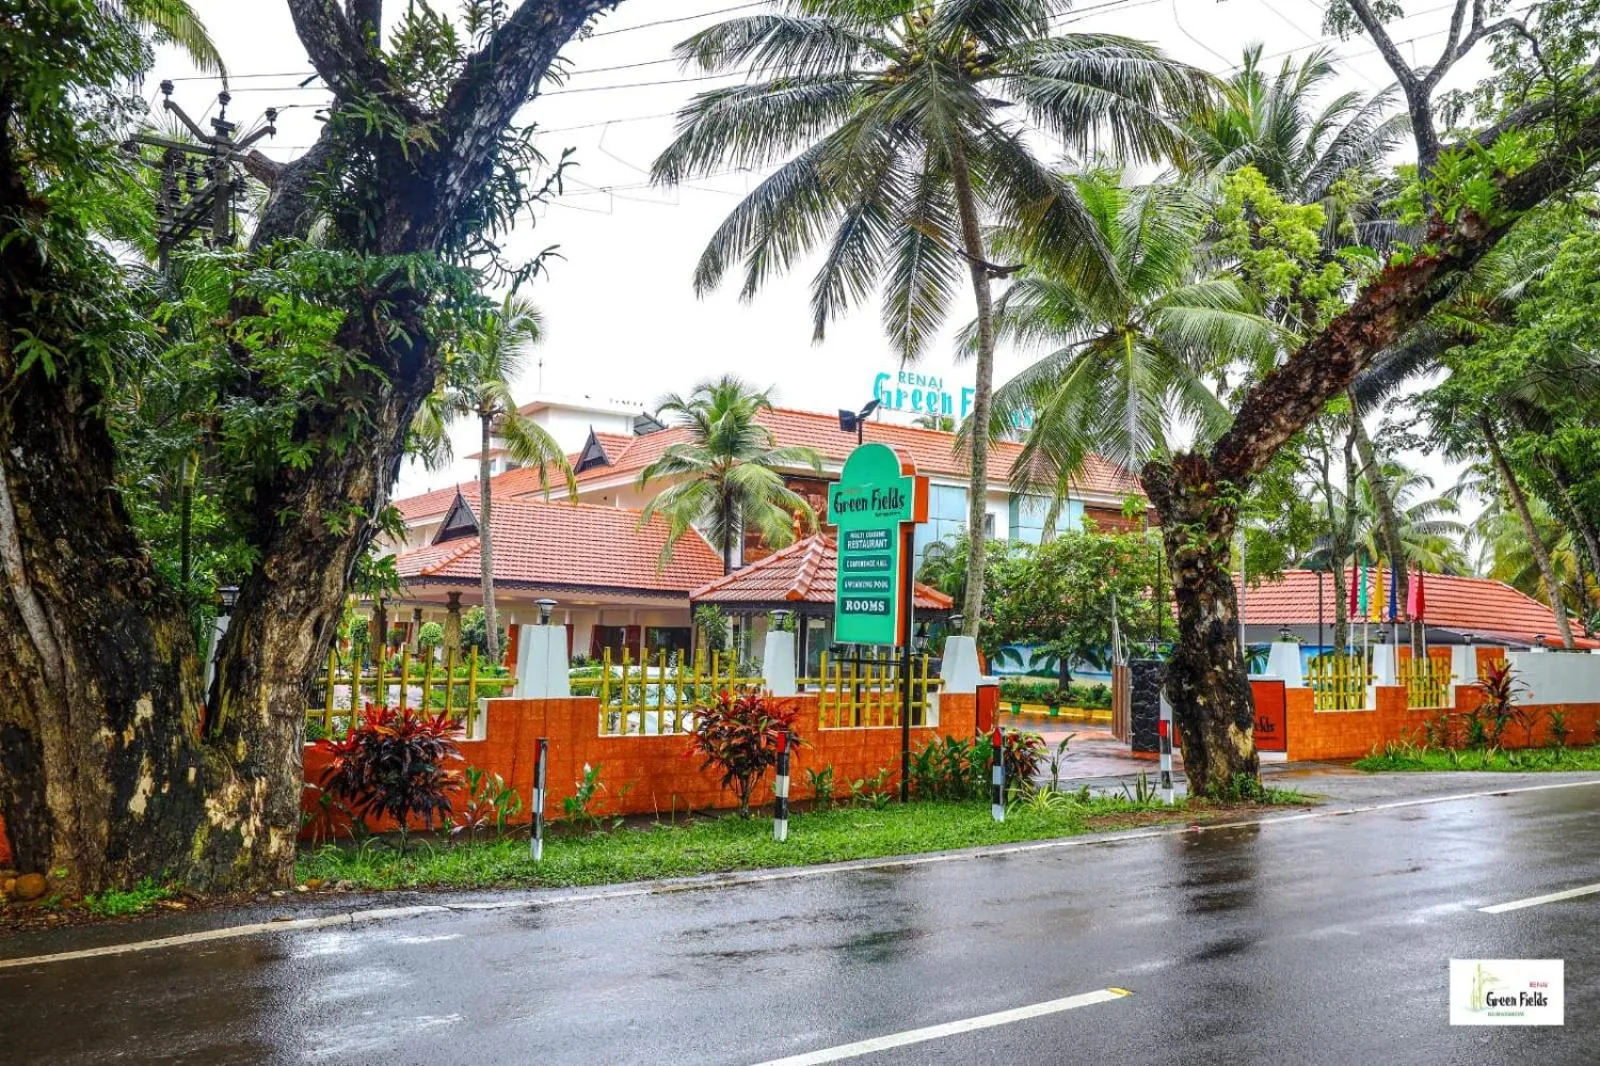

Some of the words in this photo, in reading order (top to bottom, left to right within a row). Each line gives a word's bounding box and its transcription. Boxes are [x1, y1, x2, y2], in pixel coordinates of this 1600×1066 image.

[873, 372, 952, 415] Green
[833, 491, 868, 514] Green
[872, 487, 905, 511] Fields
[847, 538, 888, 550] RESTAURANT
[845, 600, 885, 612] ROOMS
